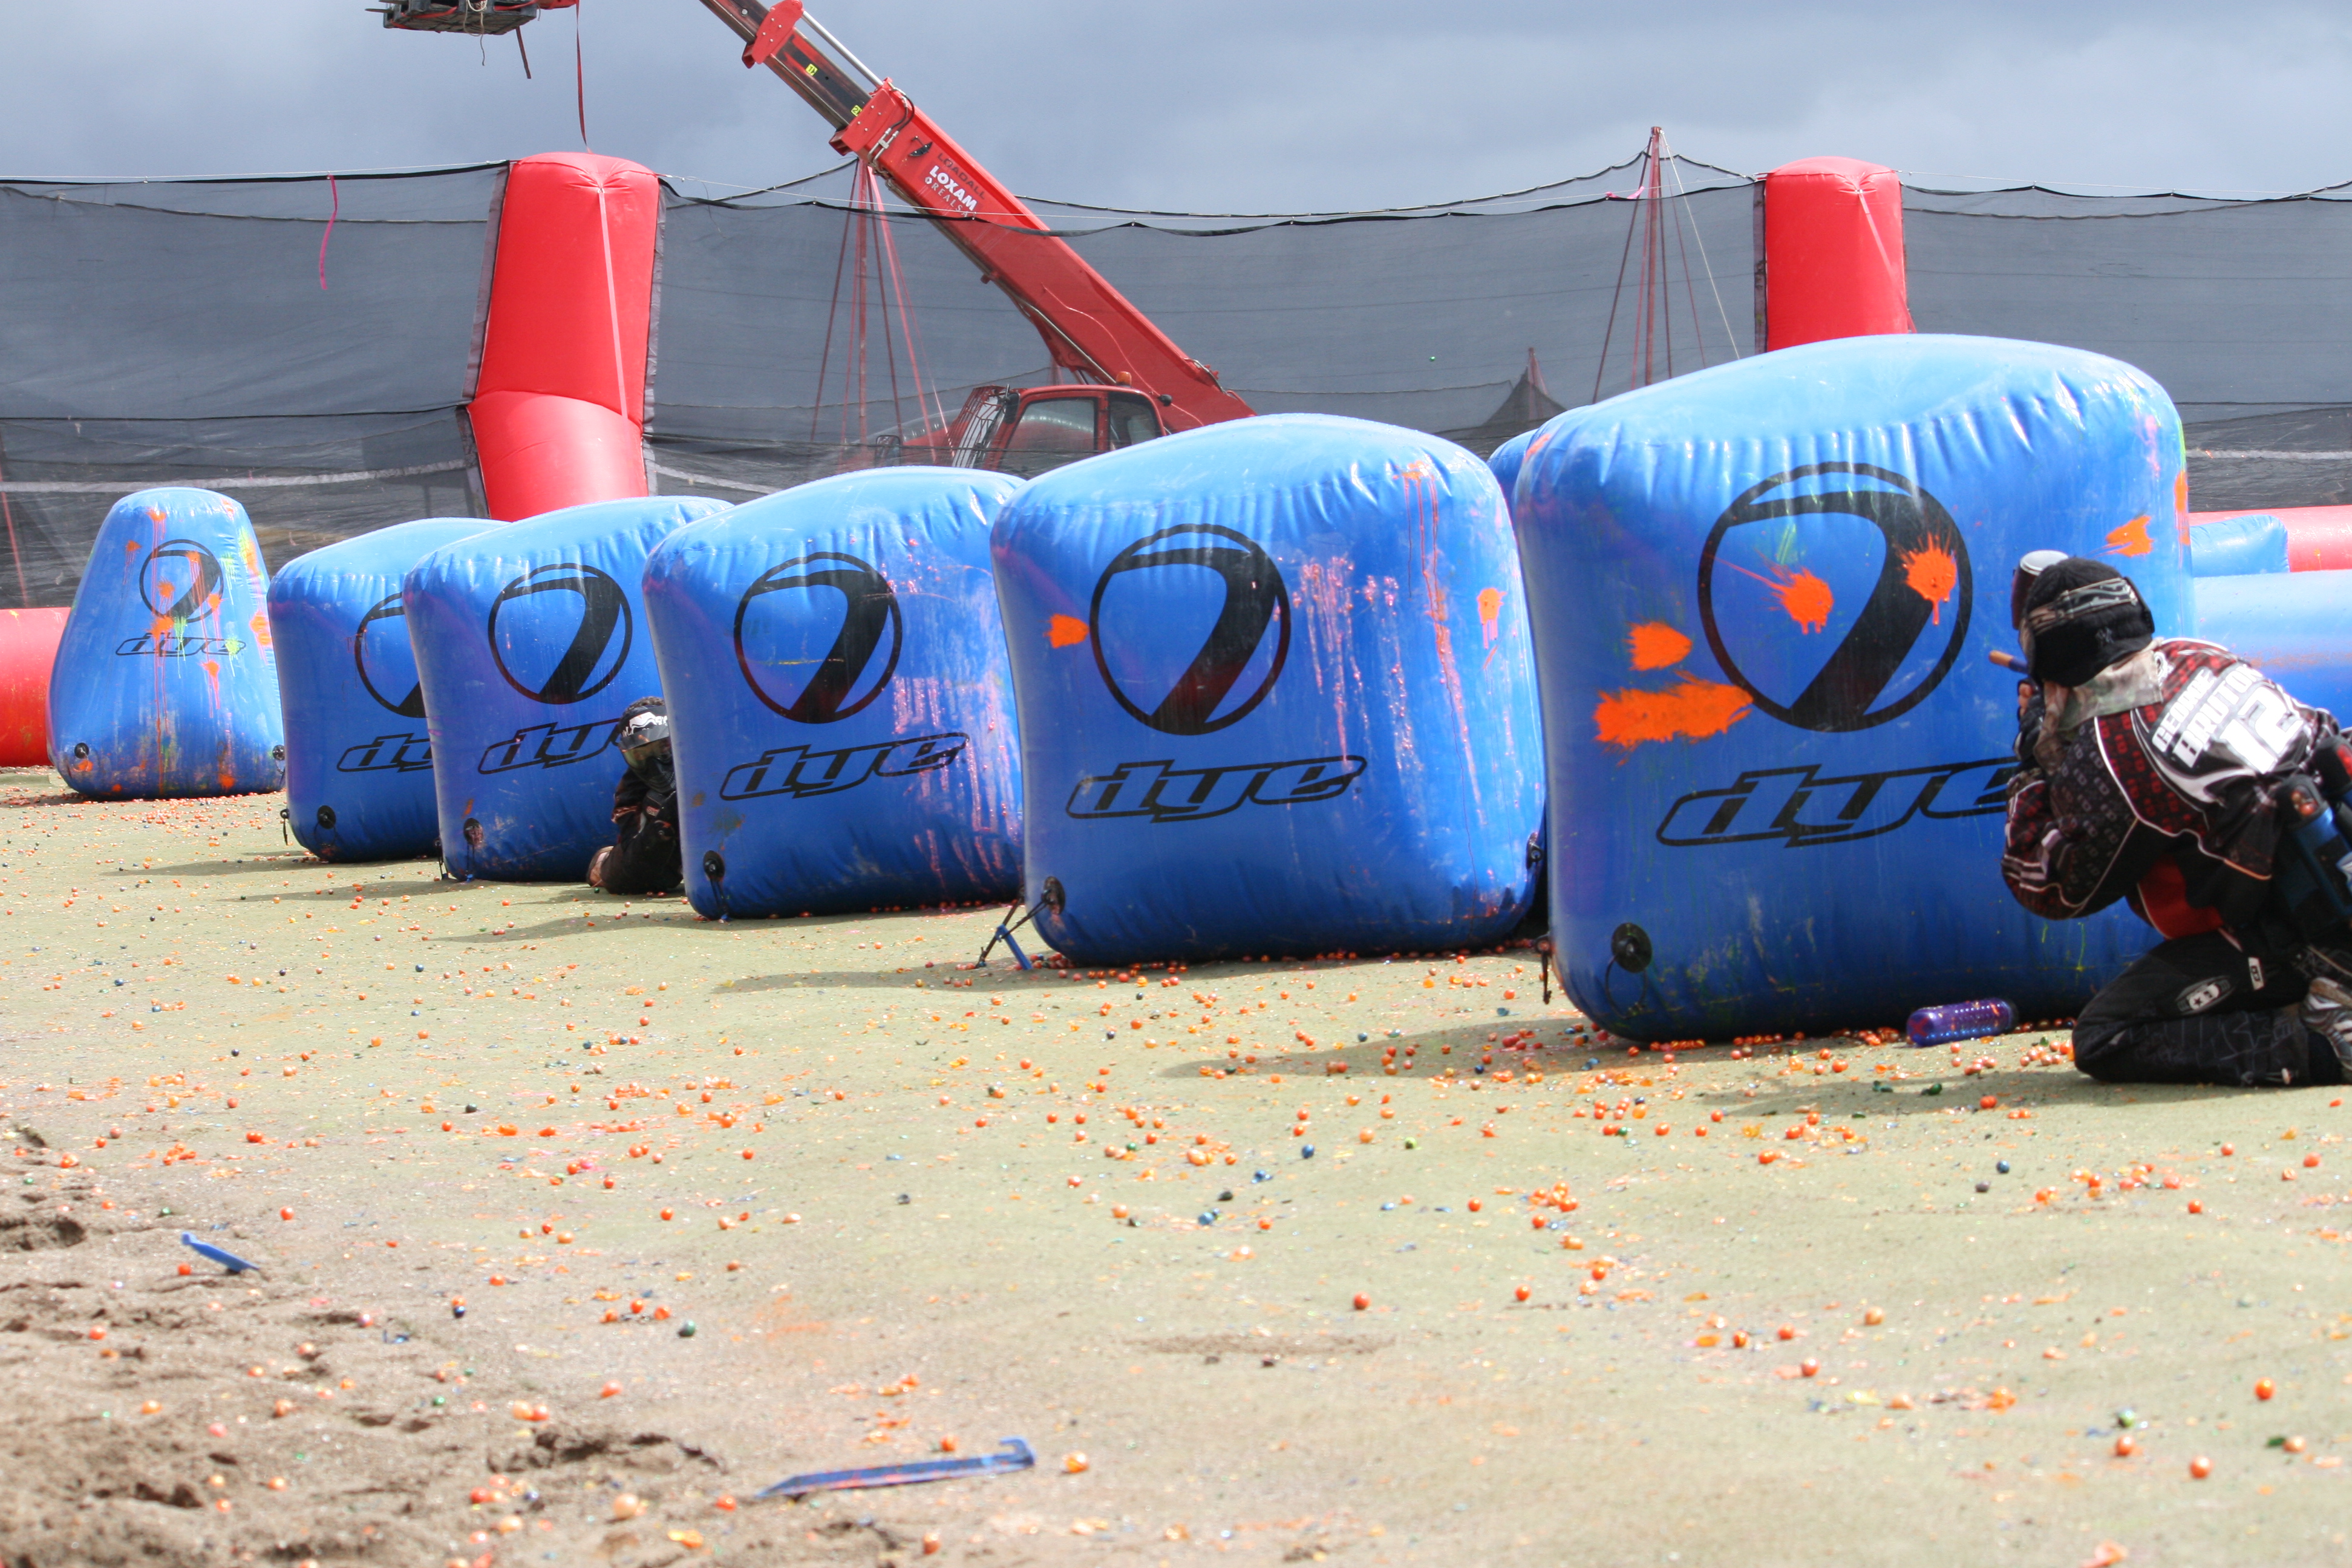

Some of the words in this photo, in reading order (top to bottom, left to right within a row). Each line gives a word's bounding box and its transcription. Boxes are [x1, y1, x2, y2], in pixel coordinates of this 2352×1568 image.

[930, 165, 978, 211] LOXAM
[938, 153, 985, 200] LOADALL
[477, 718, 621, 774] dy
[2220, 687, 2305, 774] 12
[719, 732, 970, 801] dye
[1065, 755, 1367, 824] dye
